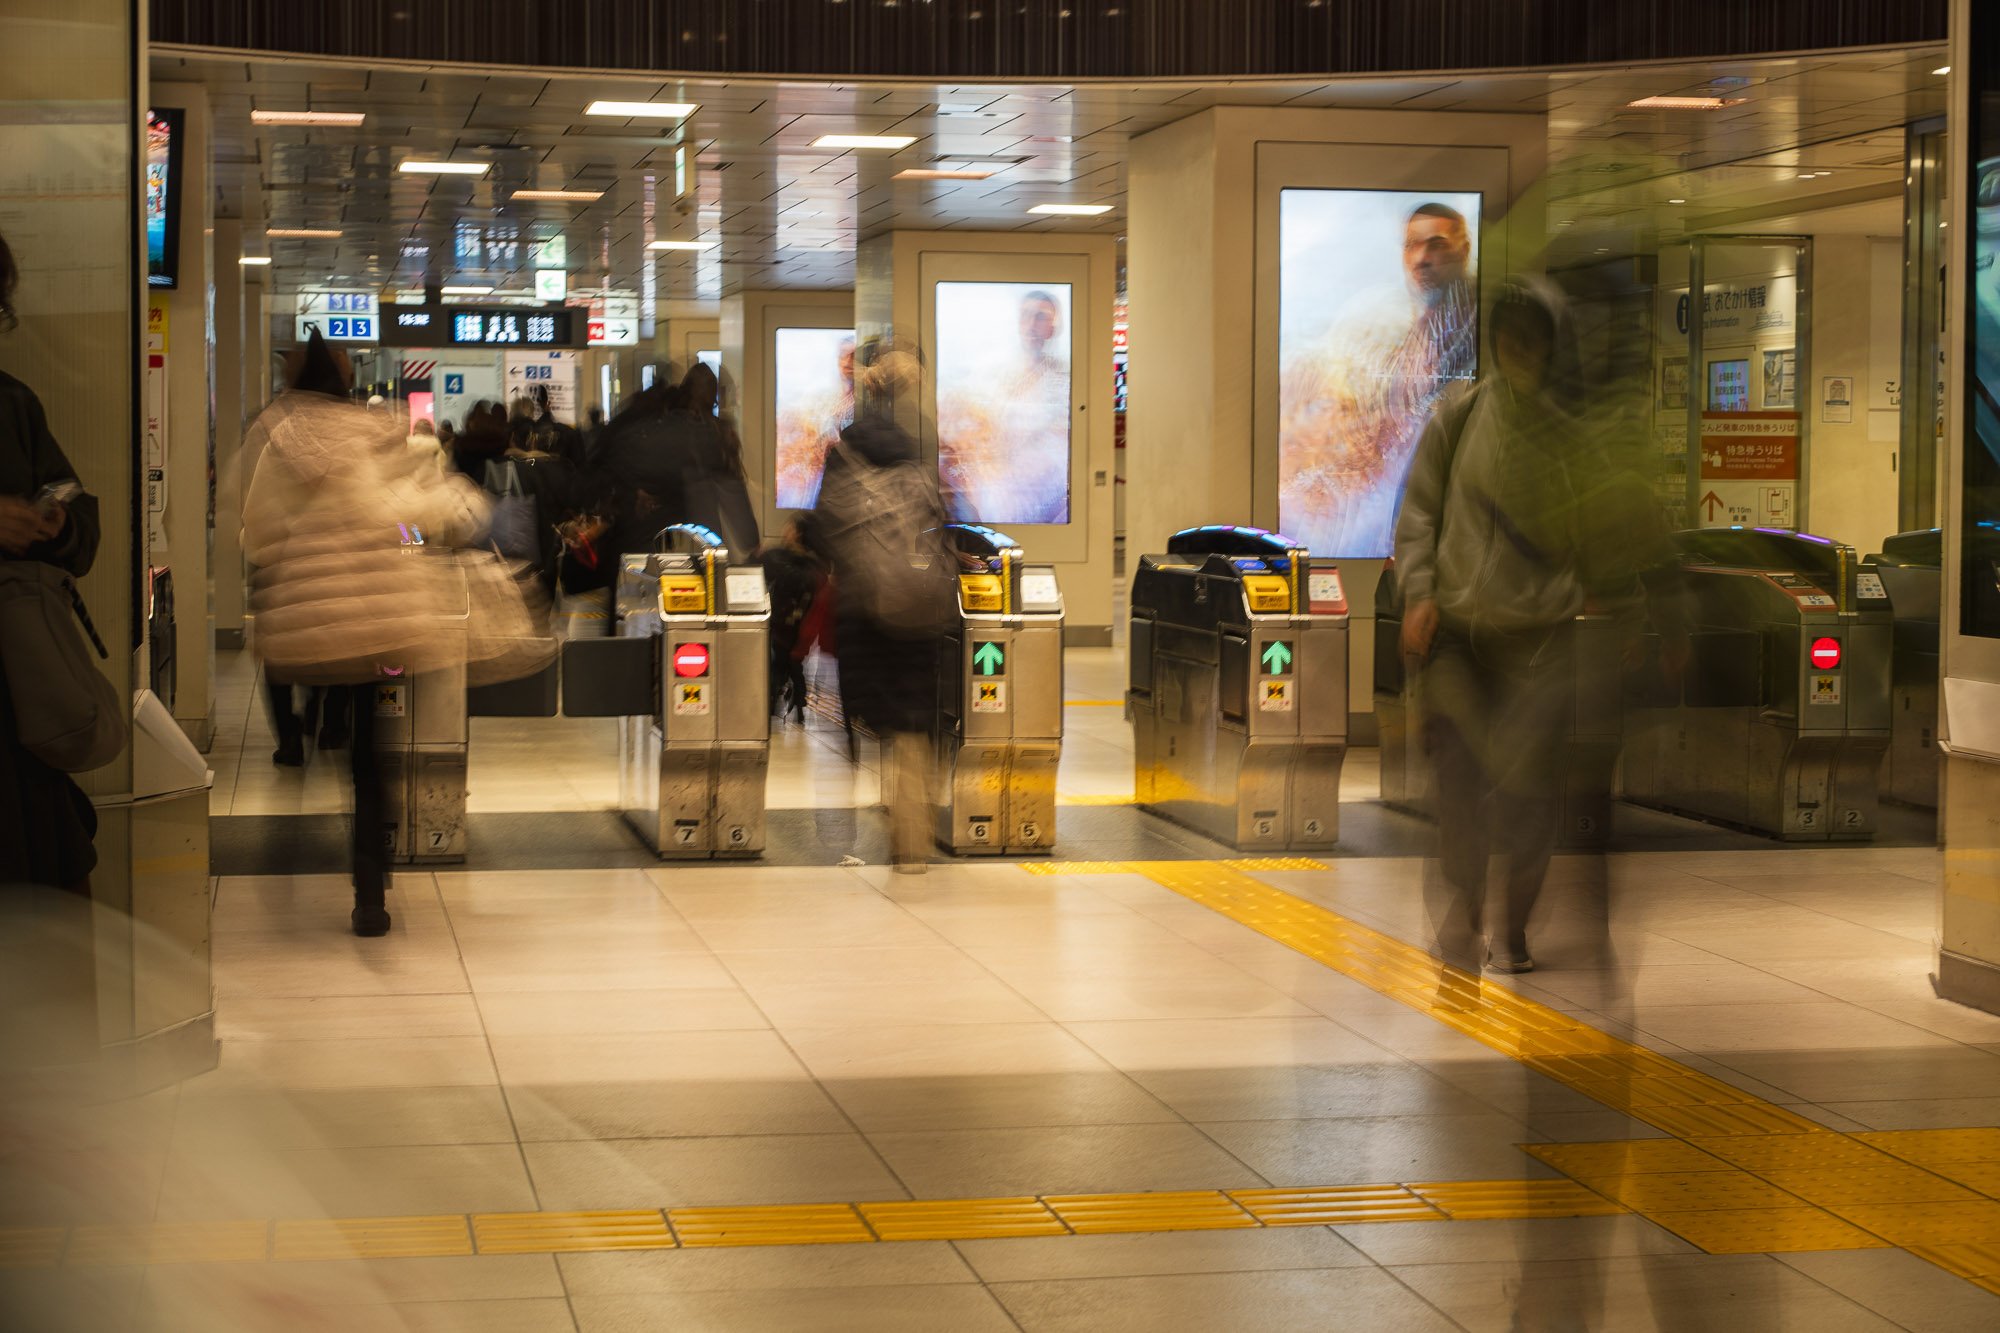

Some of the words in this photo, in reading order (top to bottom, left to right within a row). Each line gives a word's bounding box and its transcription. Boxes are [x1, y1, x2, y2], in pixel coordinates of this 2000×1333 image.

[333, 321, 344, 335] 2
[357, 321, 367, 335] 3
[448, 377, 461, 391] 4
[1726, 445, 1783, 456] 特急券うりば
[1580, 818, 1590, 830] 3
[1803, 812, 1813, 824] 3
[1847, 811, 1858, 824] 2
[975, 825, 986, 837] 6
[1023, 824, 1034, 837] 5
[1260, 821, 1270, 834] 5
[1306, 821, 1317, 833] 4
[432, 832, 443, 846] 7
[682, 828, 695, 841] 7
[732, 828, 743, 841] 6
